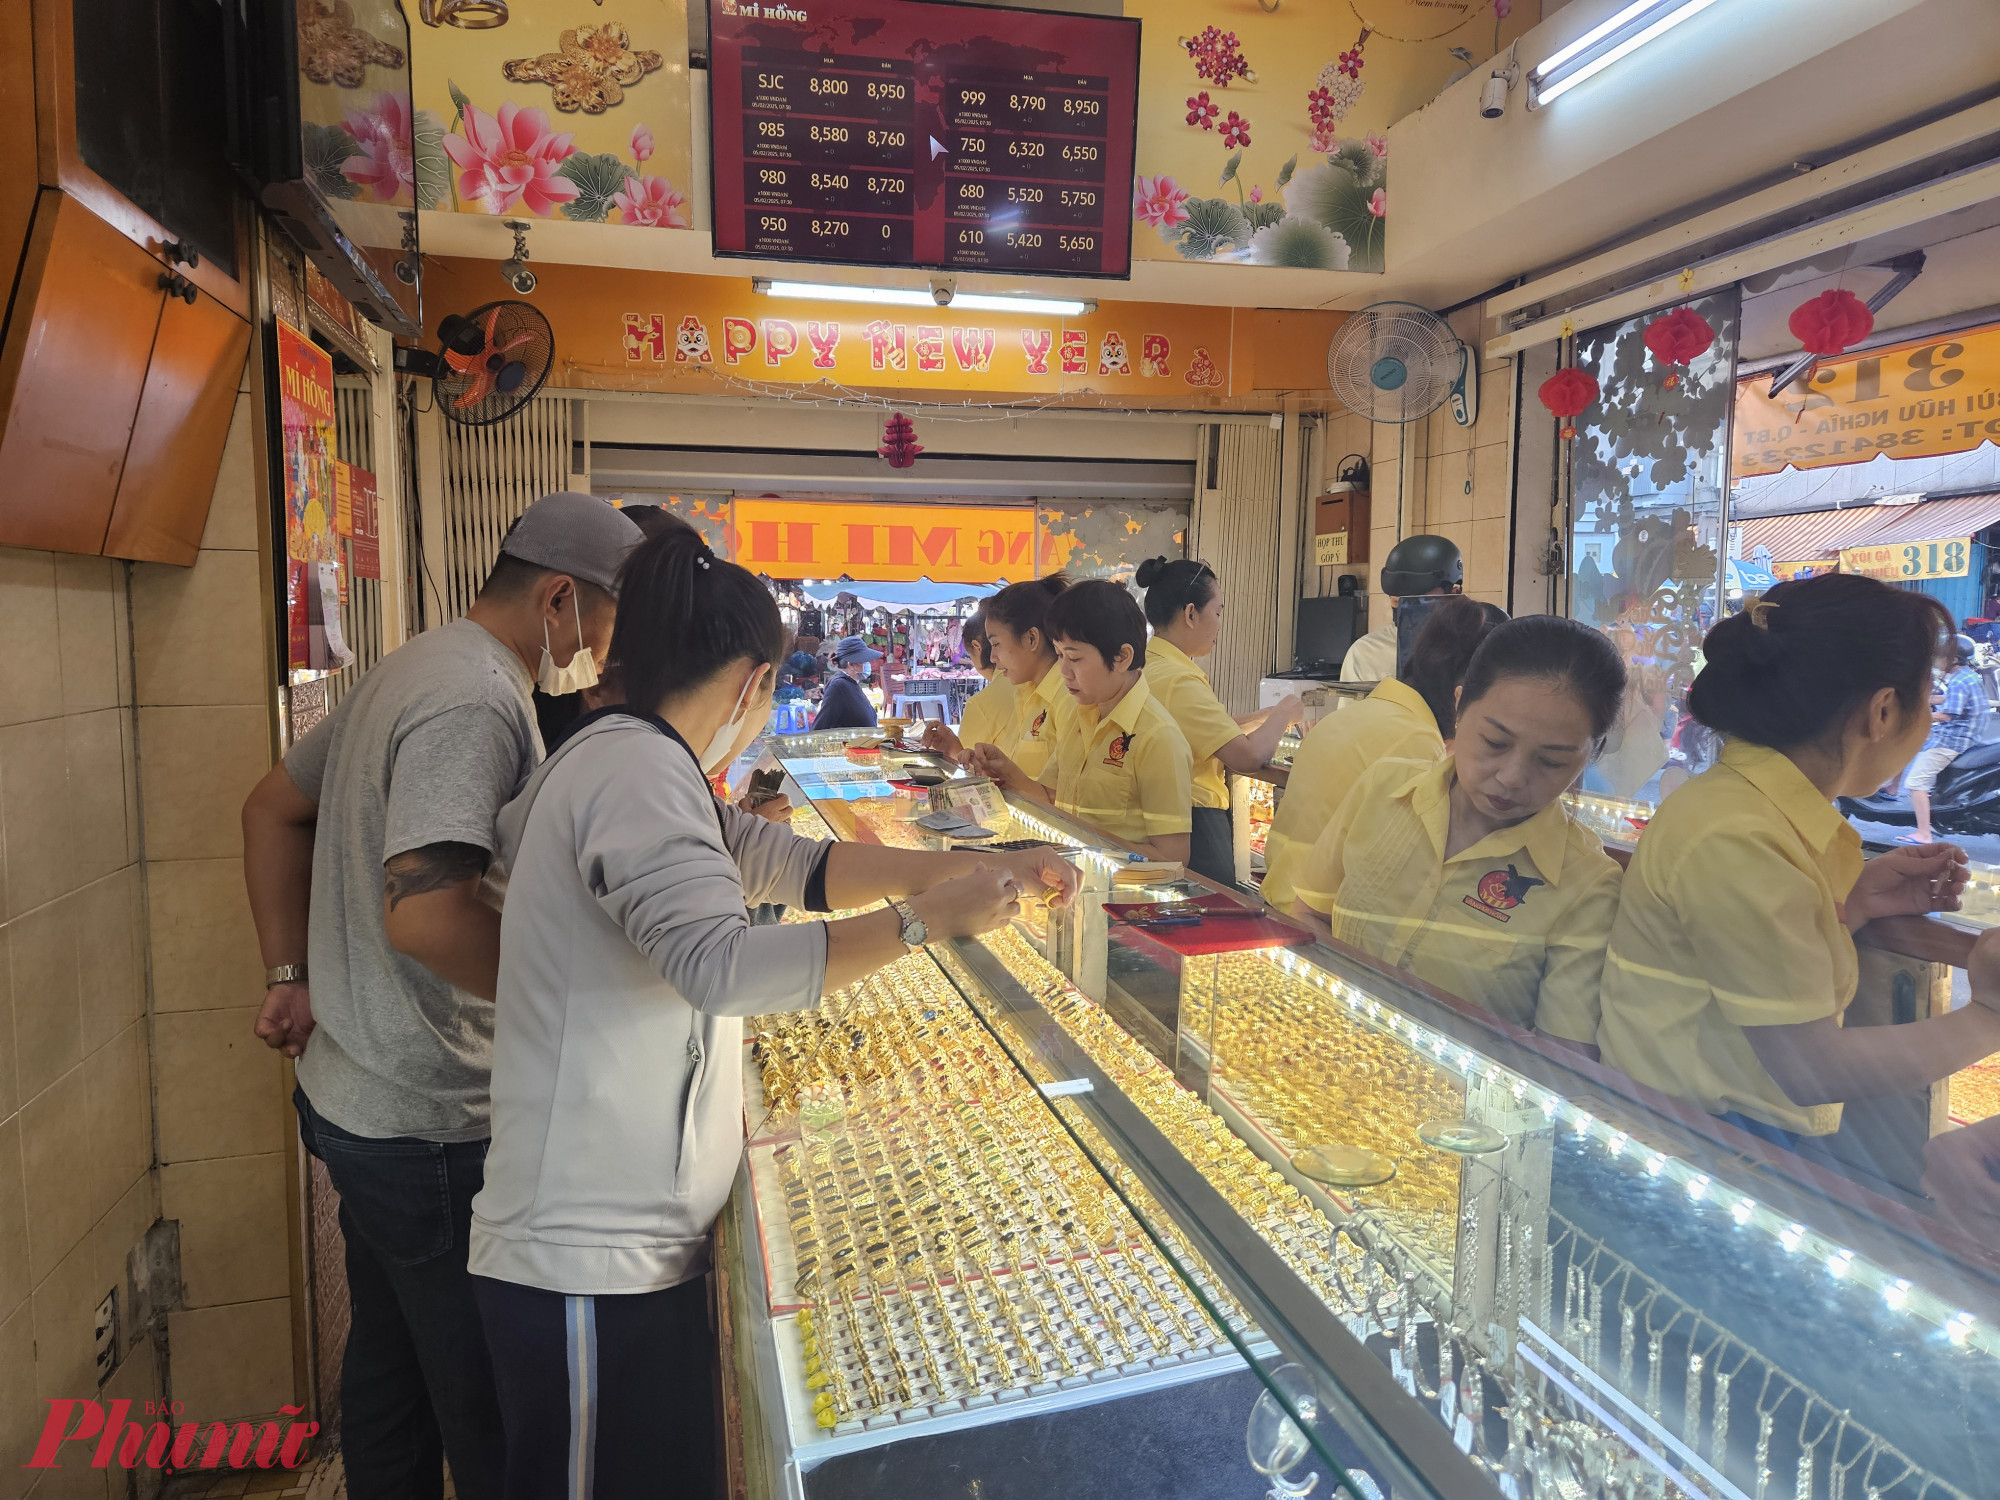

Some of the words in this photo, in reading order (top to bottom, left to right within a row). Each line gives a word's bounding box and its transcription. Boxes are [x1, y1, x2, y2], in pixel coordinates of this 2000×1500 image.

[758, 73, 784, 90] SJC
[809, 78, 848, 95] 8,800
[867, 82, 905, 100] 8,950
[961, 90, 986, 106] 999
[1009, 94, 1046, 111] 8,790
[1063, 99, 1099, 116] 8,950
[758, 121, 785, 137] 985
[810, 125, 849, 143] 8,580
[867, 130, 905, 148] 8,760
[960, 137, 985, 153] 750
[1008, 141, 1044, 158] 6,320
[1062, 145, 1098, 162] 6,550
[759, 169, 786, 185] 980
[810, 173, 849, 190] 8,540
[867, 177, 905, 194] 8,720
[959, 184, 985, 199] 680
[1007, 187, 1043, 204] 5,520
[1060, 190, 1096, 207] 5,750
[760, 216, 787, 232] 950
[811, 220, 849, 237] 8,270
[881, 224, 891, 239] 0
[959, 230, 984, 244] 610
[1006, 232, 1042, 249] 5,420
[1059, 235, 1094, 252] 5,650
[621, 313, 841, 369] HAPPY
[862, 320, 996, 373] NEW
[1021, 329, 1172, 378] YEAR
[1317, 537, 1331, 550] HỘP
[1331, 535, 1347, 546] THƯ
[1320, 550, 1335, 563] GÓP
[1335, 549, 1341, 562] Ý
[1851, 550, 1871, 564] XÔI
[1875, 548, 1892, 562] GÀ
[1902, 541, 1966, 576] 318
[1739, 570, 1771, 585] be
